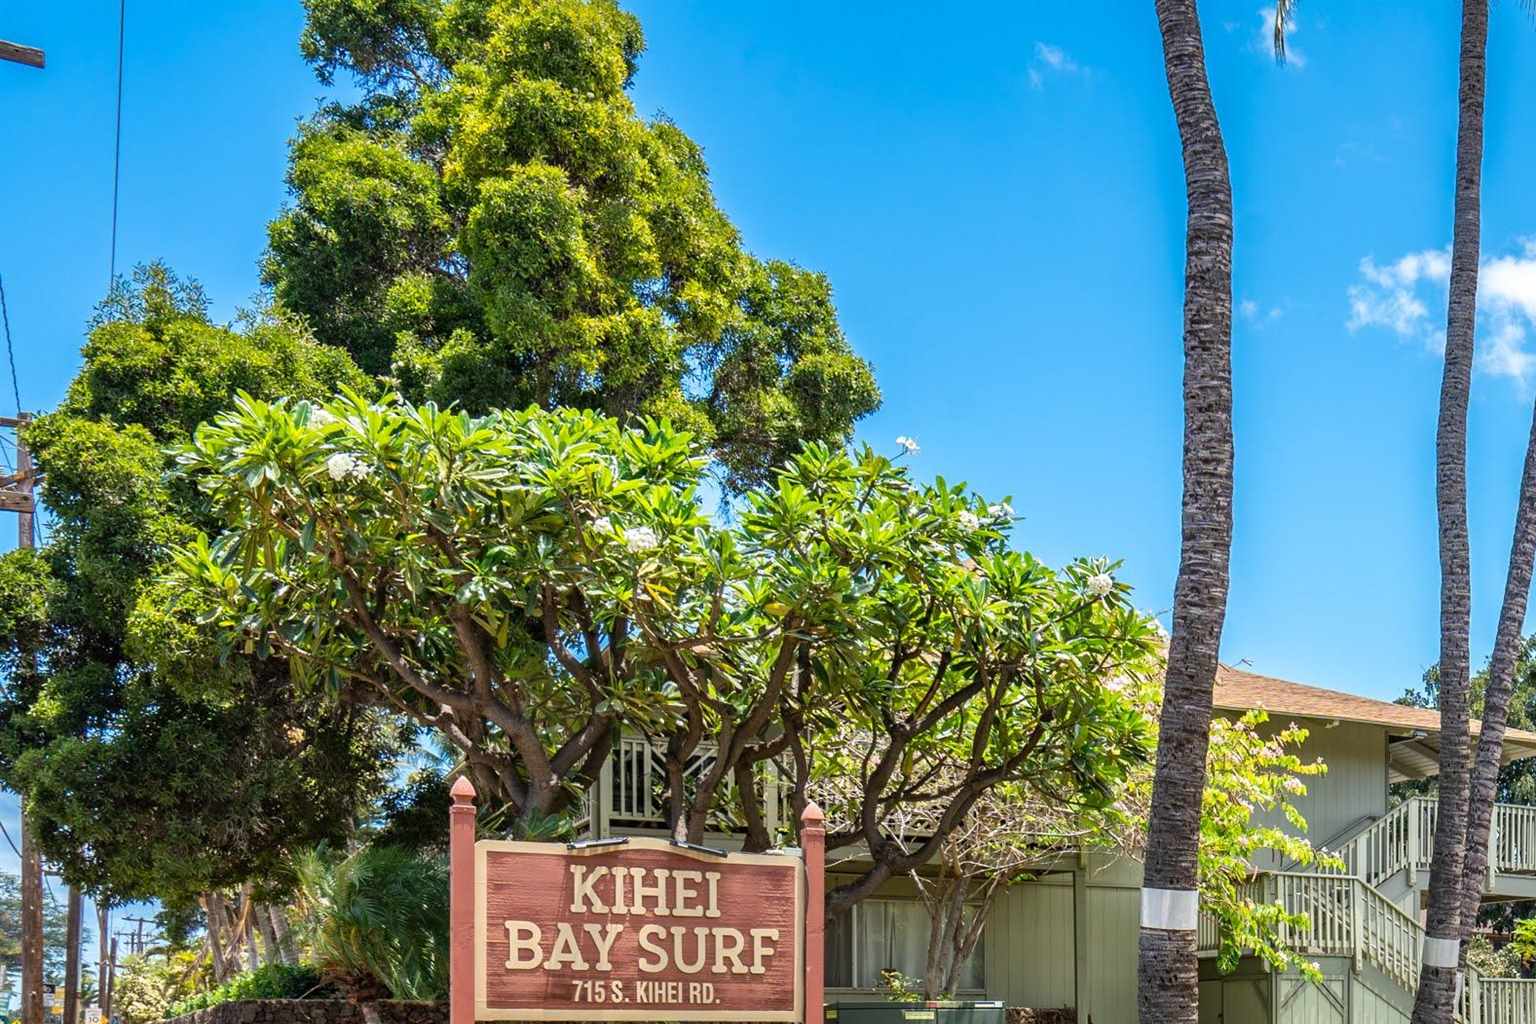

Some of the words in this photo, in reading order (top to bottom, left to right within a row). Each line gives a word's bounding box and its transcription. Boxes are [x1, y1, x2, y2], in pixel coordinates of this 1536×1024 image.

[570, 864, 721, 917] KIHEI
[504, 920, 623, 971] BAY
[638, 925, 779, 974] SURF
[572, 981, 605, 1002] 715
[611, 981, 629, 1002] S.
[636, 981, 683, 1004] KIHEI
[690, 982, 720, 1004] RD.
